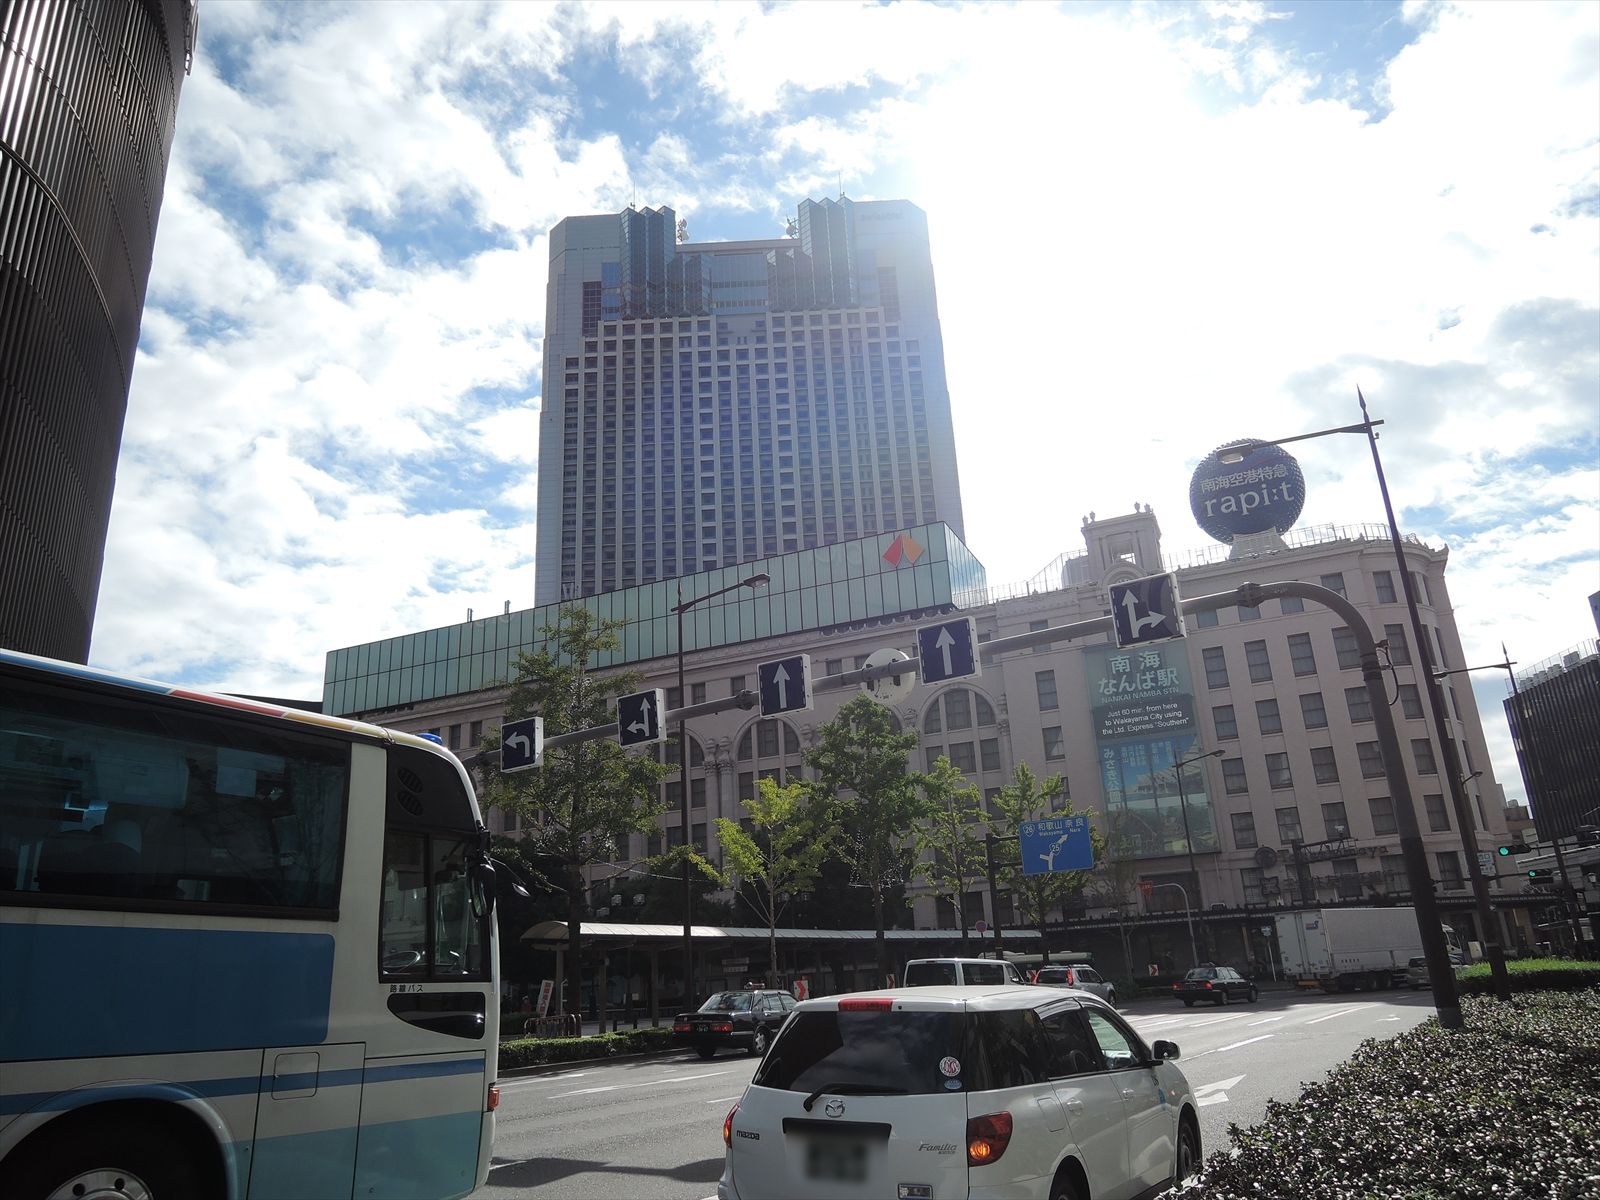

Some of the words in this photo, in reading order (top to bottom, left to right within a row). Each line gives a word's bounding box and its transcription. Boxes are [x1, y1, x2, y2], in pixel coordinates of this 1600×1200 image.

[1200, 463, 1288, 494] 南海空港特急
[1109, 651, 1161, 674] 南海
[1099, 667, 1179, 695] なんば駅
[1101, 693, 1131, 704] NANKAI
[1132, 690, 1162, 699] NAMBA
[1163, 686, 1179, 695] STN
[1107, 710, 1121, 718] Just
[1112, 715, 1149, 726] Wakayama
[1164, 710, 1182, 719] using
[1127, 722, 1154, 732] Express
[1038, 821, 1062, 830] 和歌山
[918, 1143, 958, 1152] Familia
